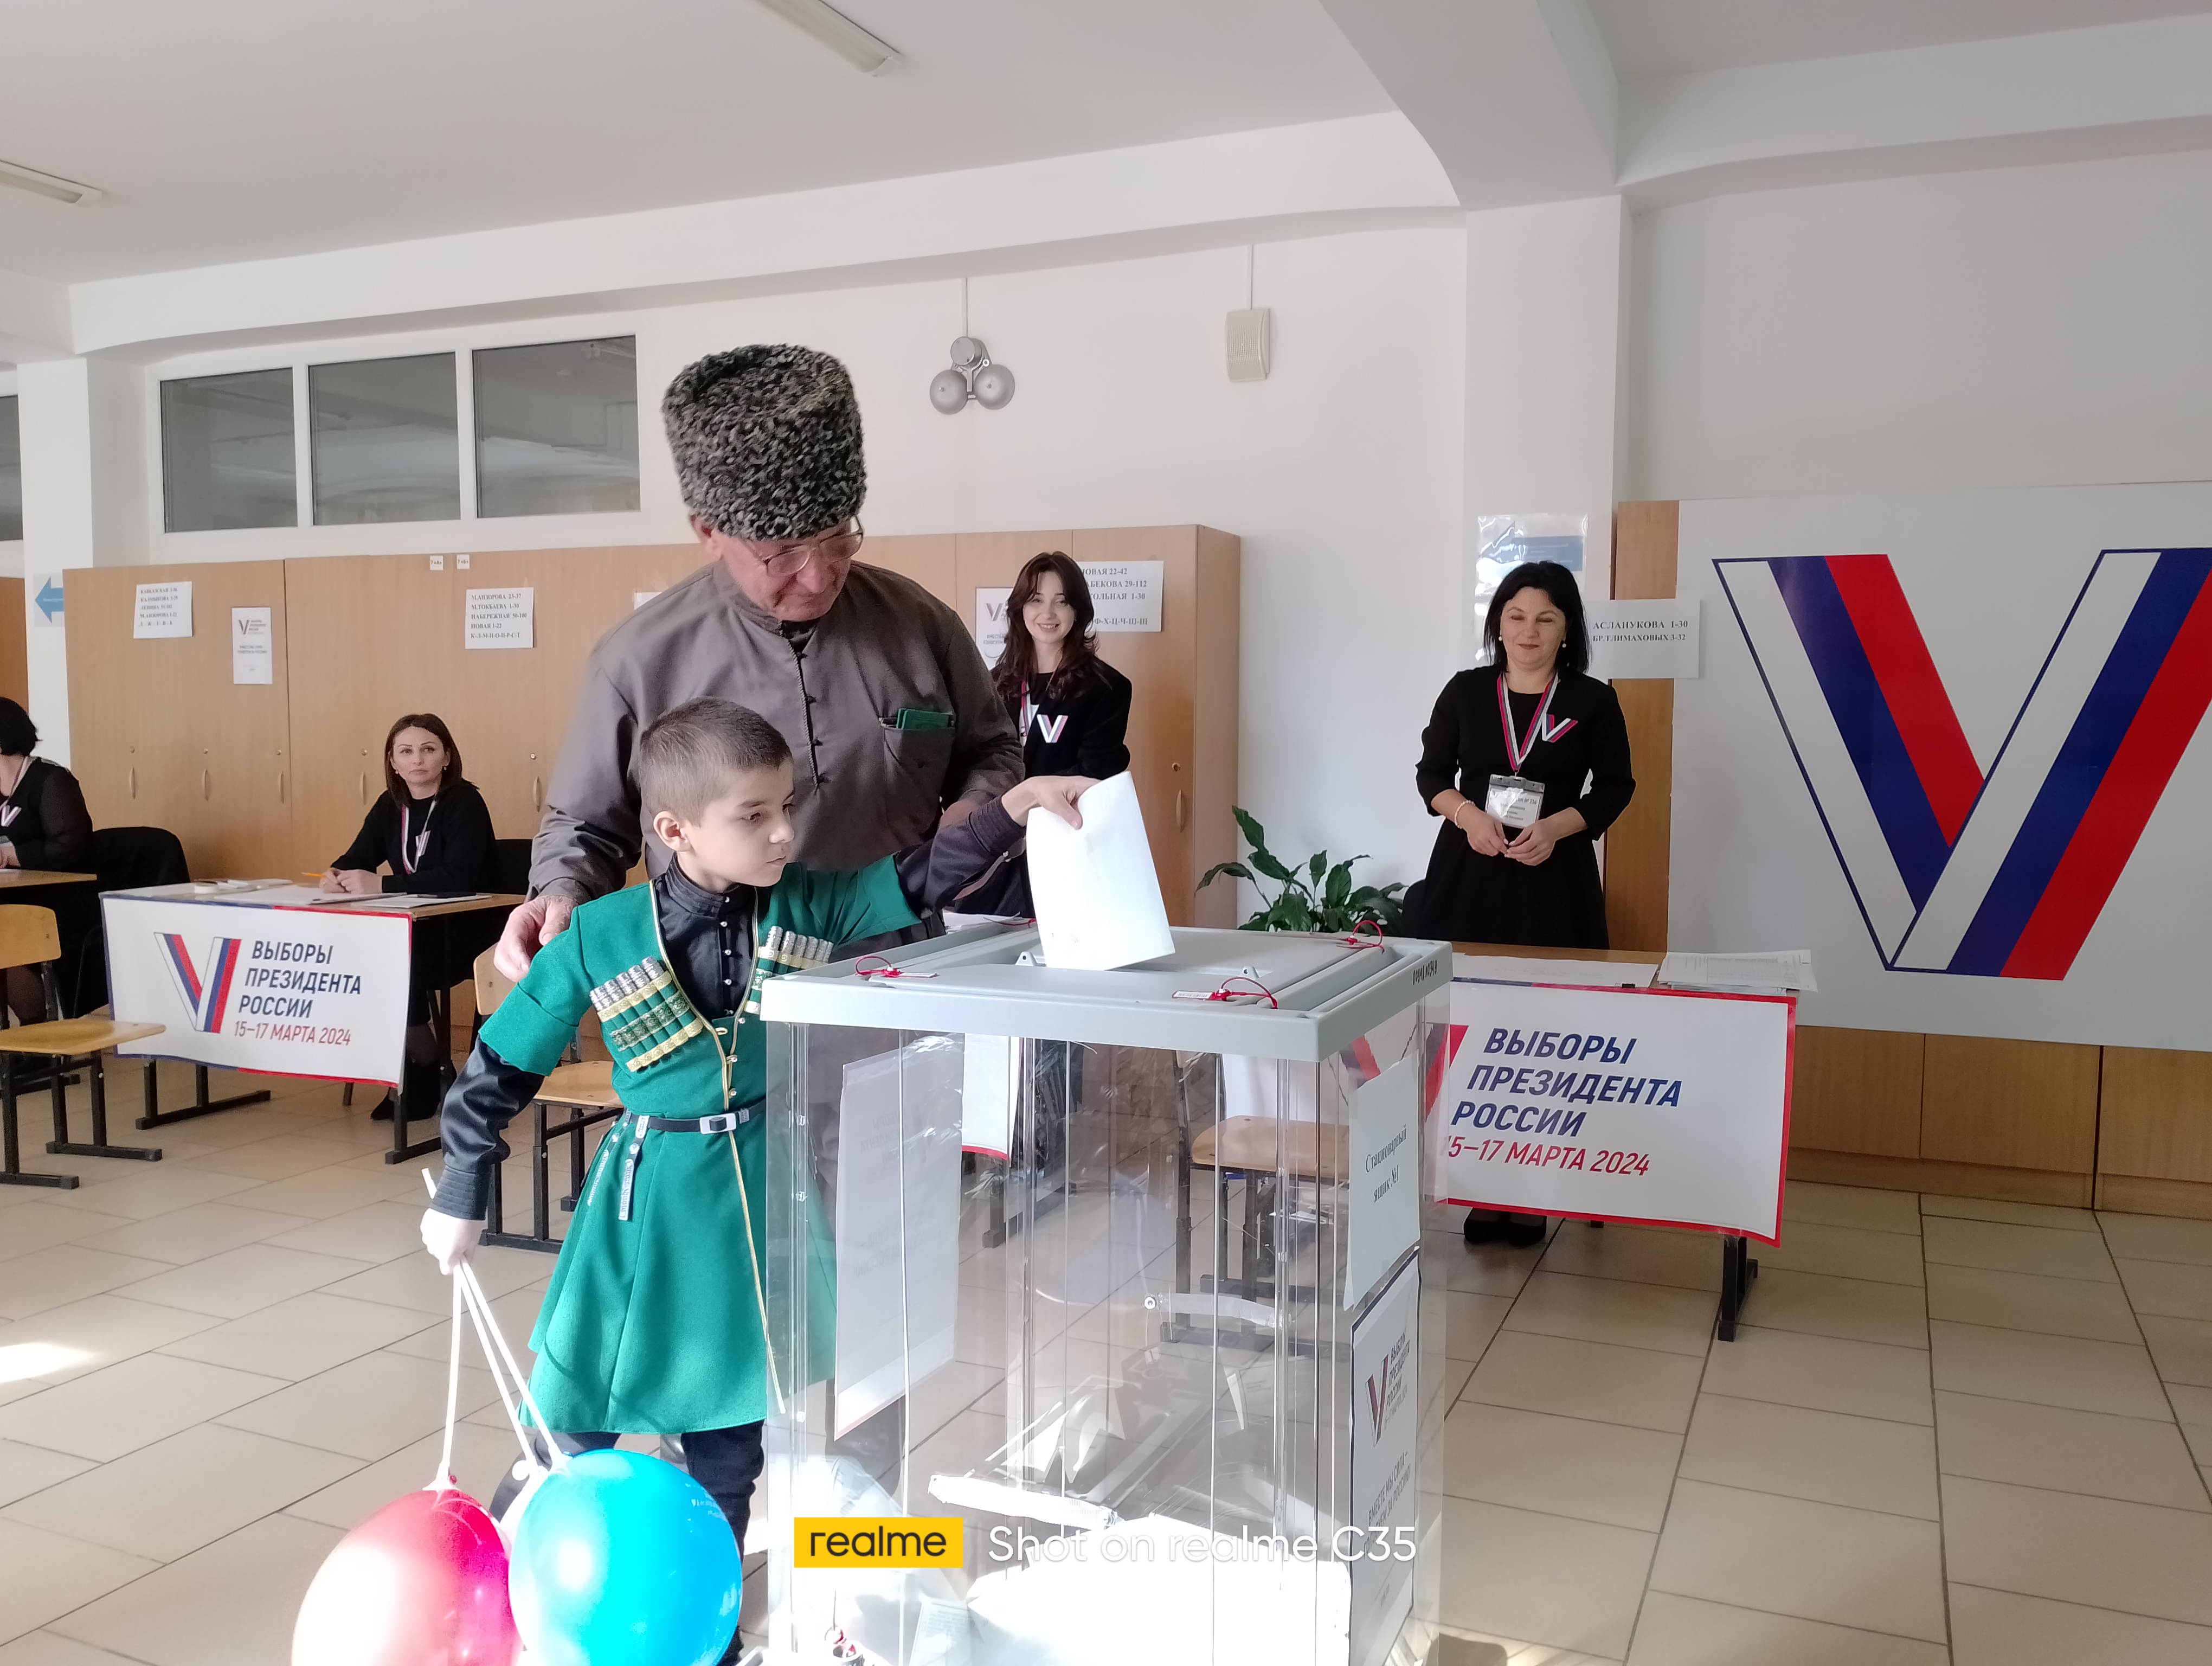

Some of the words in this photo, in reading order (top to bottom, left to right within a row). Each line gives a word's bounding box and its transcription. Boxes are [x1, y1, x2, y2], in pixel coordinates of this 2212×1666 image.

[251, 940, 333, 964] ВЫБОРЫ
[245, 968, 361, 995] ПРЕЗИДЕНТА
[239, 995, 314, 1018] РОССИИ
[270, 1024, 316, 1043] МАРТА
[318, 1027, 351, 1046] 2024
[1483, 1028, 1637, 1064] ВЫБОРЫ
[1467, 1065, 1682, 1107] ПРЕЗИДЕНТА
[1451, 1101, 1586, 1137] РОССИИ
[1366, 1123, 1406, 1172] Стационарный
[1505, 1142, 1586, 1170] МАРТА
[1589, 1150, 1650, 1176] 2024
